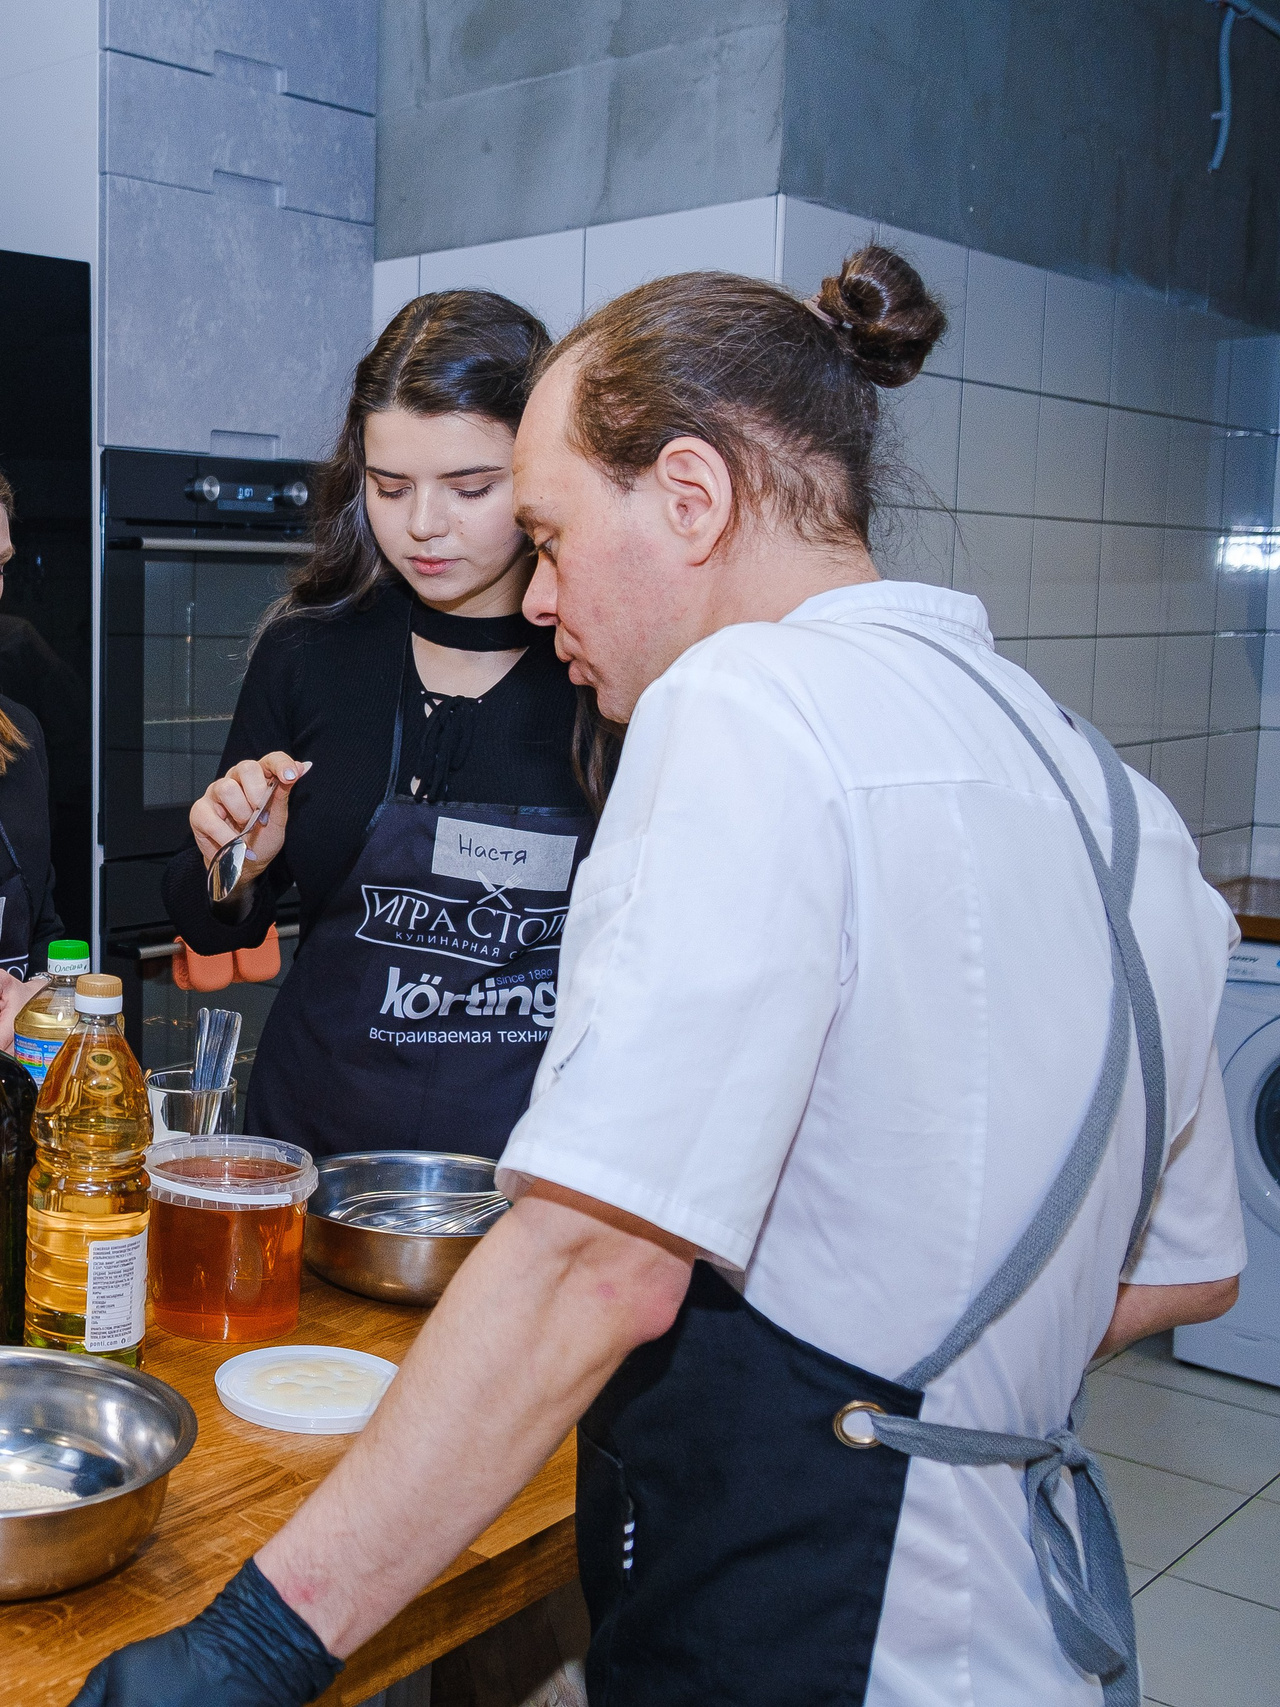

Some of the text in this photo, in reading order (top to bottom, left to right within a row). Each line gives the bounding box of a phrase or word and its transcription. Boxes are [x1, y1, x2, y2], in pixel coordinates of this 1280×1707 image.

[459, 834, 527, 865] Настя
[373, 892, 567, 946] ИГРА СТОЛ
[396, 931, 500, 957] КУЛИНАРНАЯ
[496, 968, 553, 986] since 1880
[379, 966, 558, 1027] körting
[369, 1027, 552, 1046] встраиваемая техни
